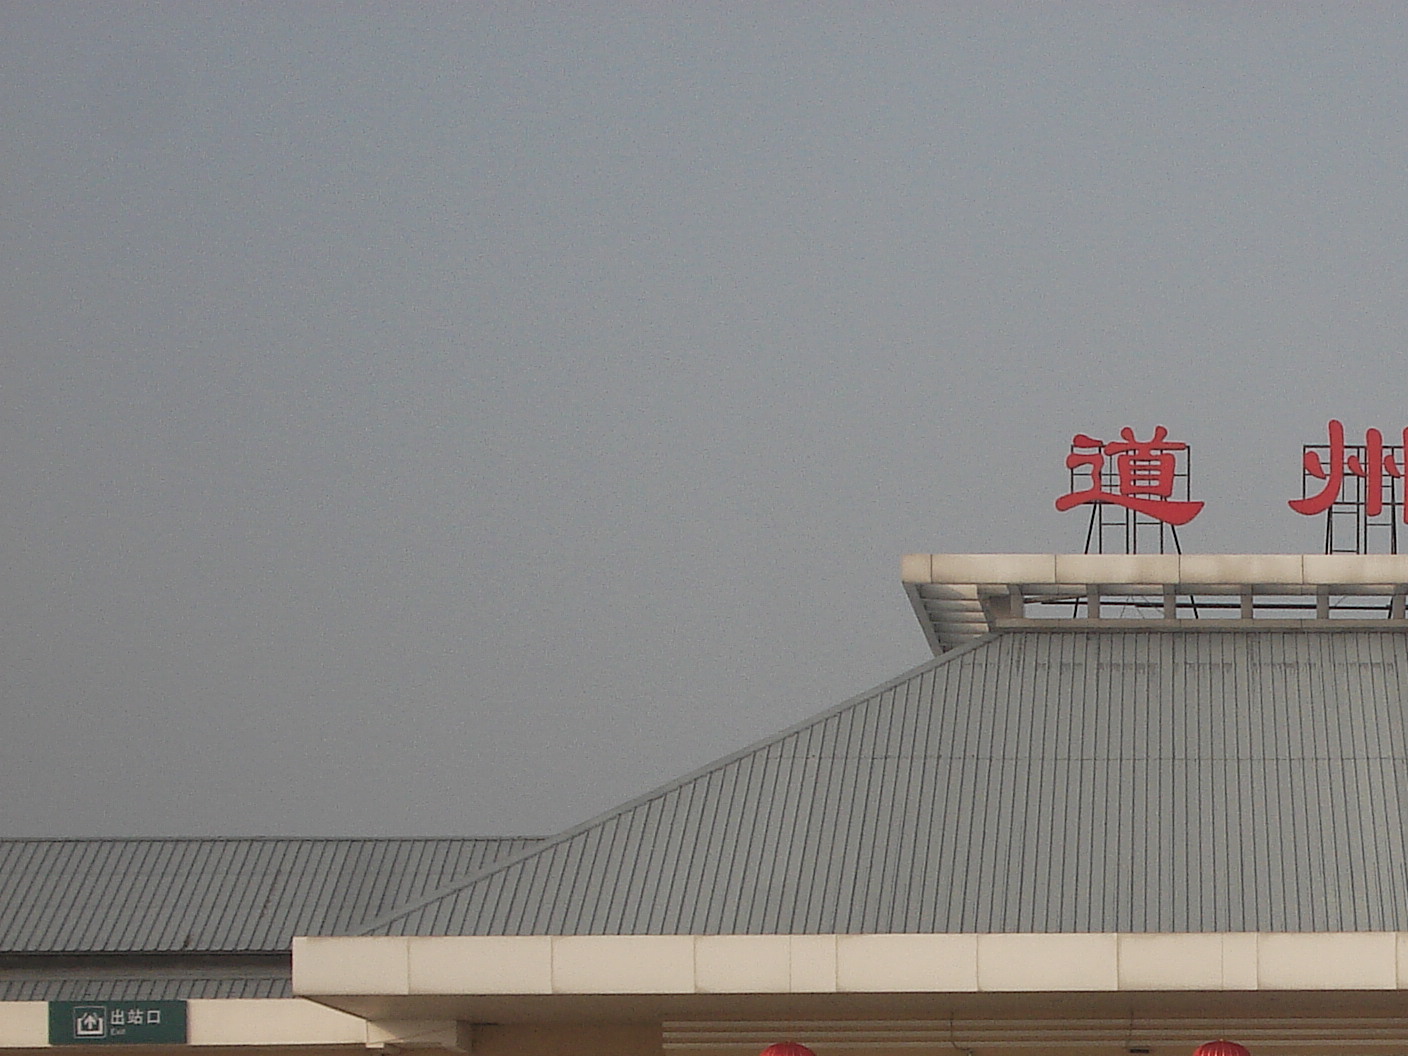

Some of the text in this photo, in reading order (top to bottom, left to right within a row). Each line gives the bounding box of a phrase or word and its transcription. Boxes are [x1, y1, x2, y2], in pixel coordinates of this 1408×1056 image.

[111, 1009, 160, 1025] 出站口
[111, 1027, 126, 1036] Exit
